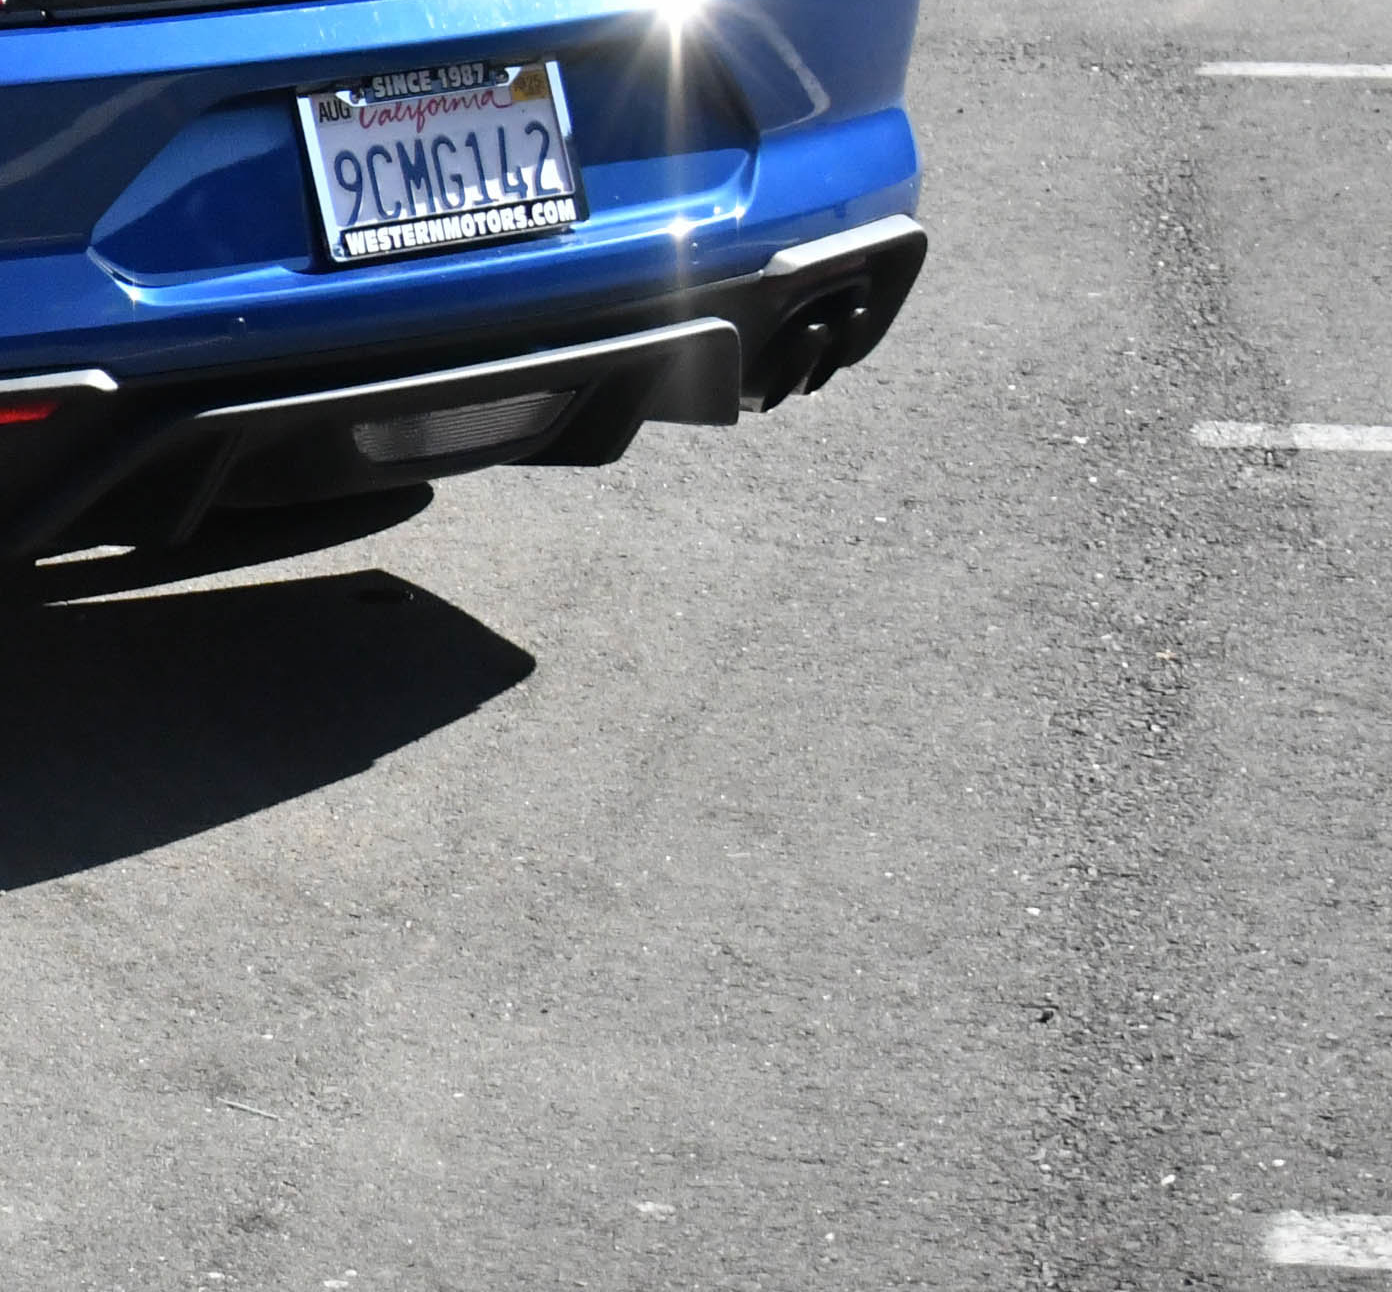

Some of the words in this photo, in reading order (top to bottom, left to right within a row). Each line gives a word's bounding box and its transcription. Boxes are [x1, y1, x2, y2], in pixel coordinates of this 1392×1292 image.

[372, 70, 432, 98] SINCE
[437, 62, 485, 88] 1987
[319, 98, 352, 123] AUG
[359, 87, 513, 133] California
[334, 120, 561, 226] 9CMG142
[345, 198, 577, 256] WESTERNMOTORS.COM
